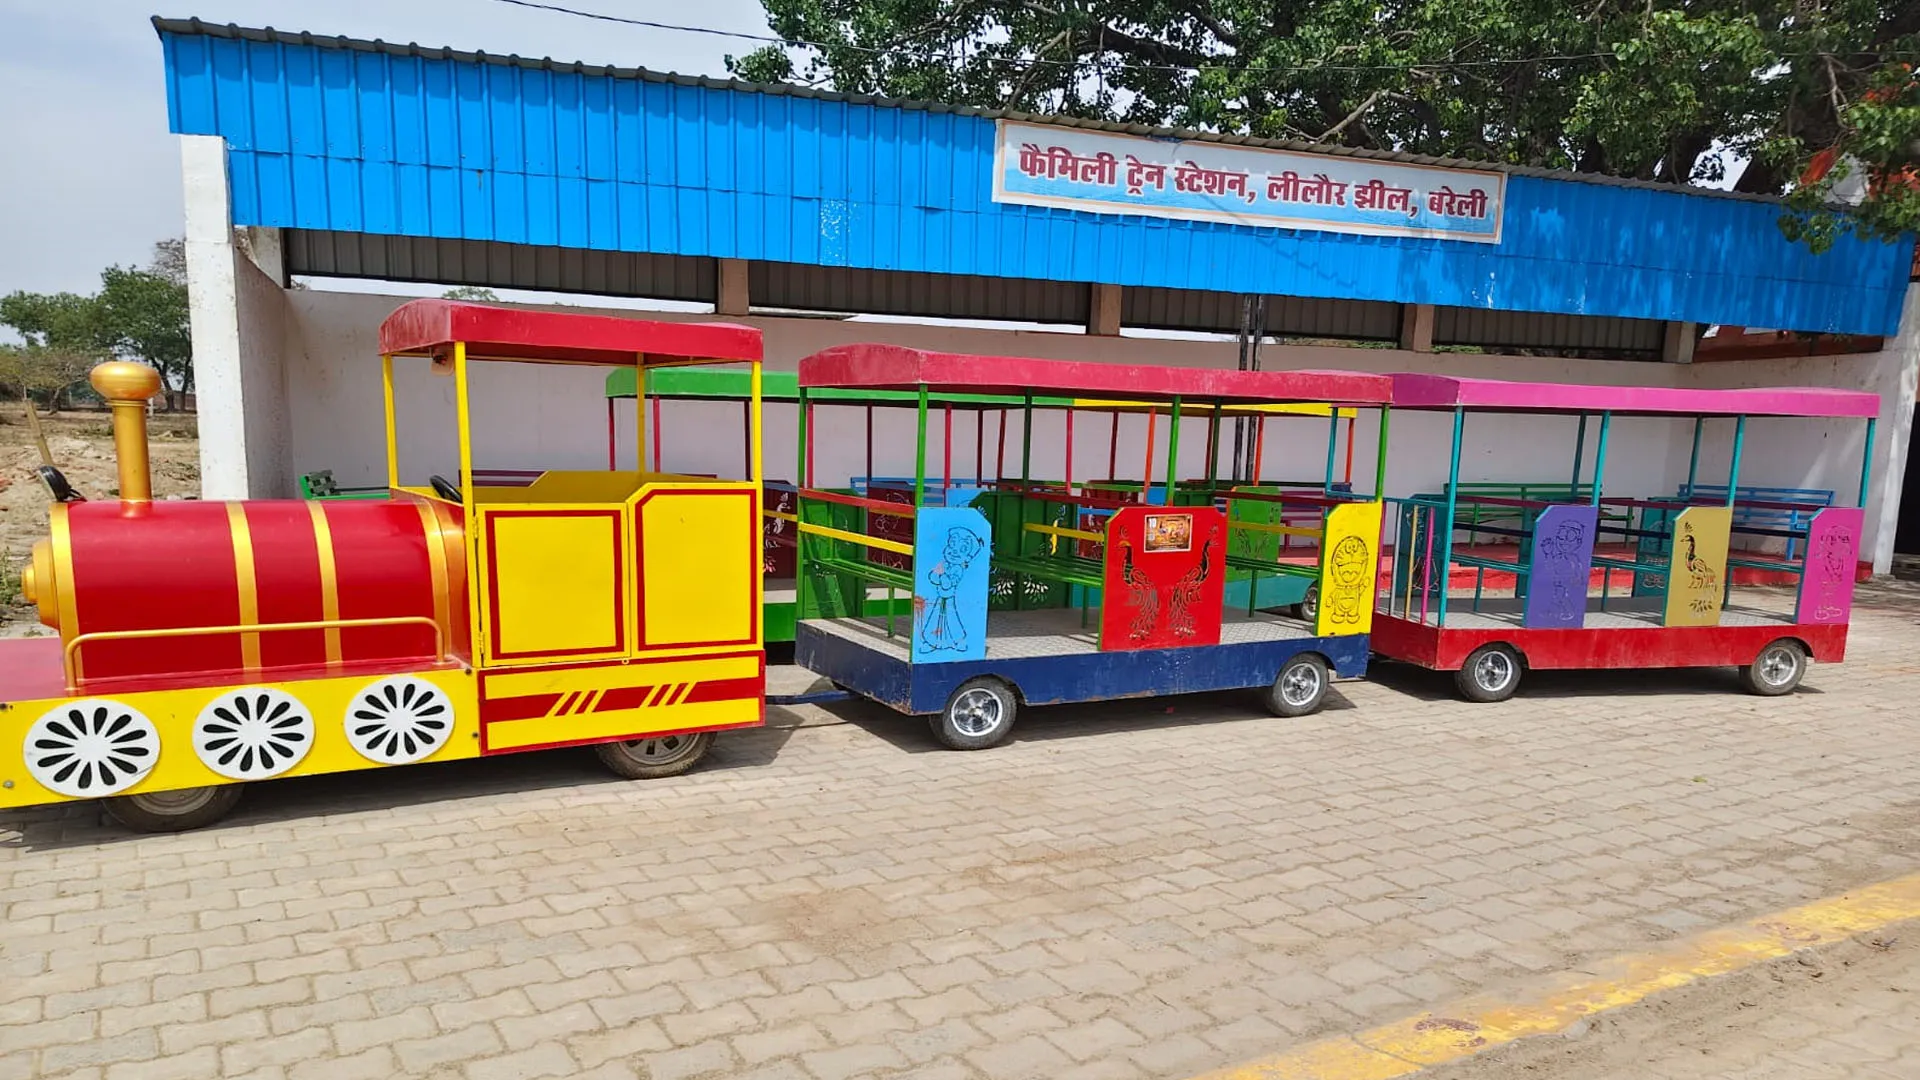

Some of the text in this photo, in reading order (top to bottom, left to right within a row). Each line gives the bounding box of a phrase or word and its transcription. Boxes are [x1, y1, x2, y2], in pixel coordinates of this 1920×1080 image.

[1019, 143, 1488, 218] फैमिली ट्रेन स्टेशन, लीलौर झील, बरेली
